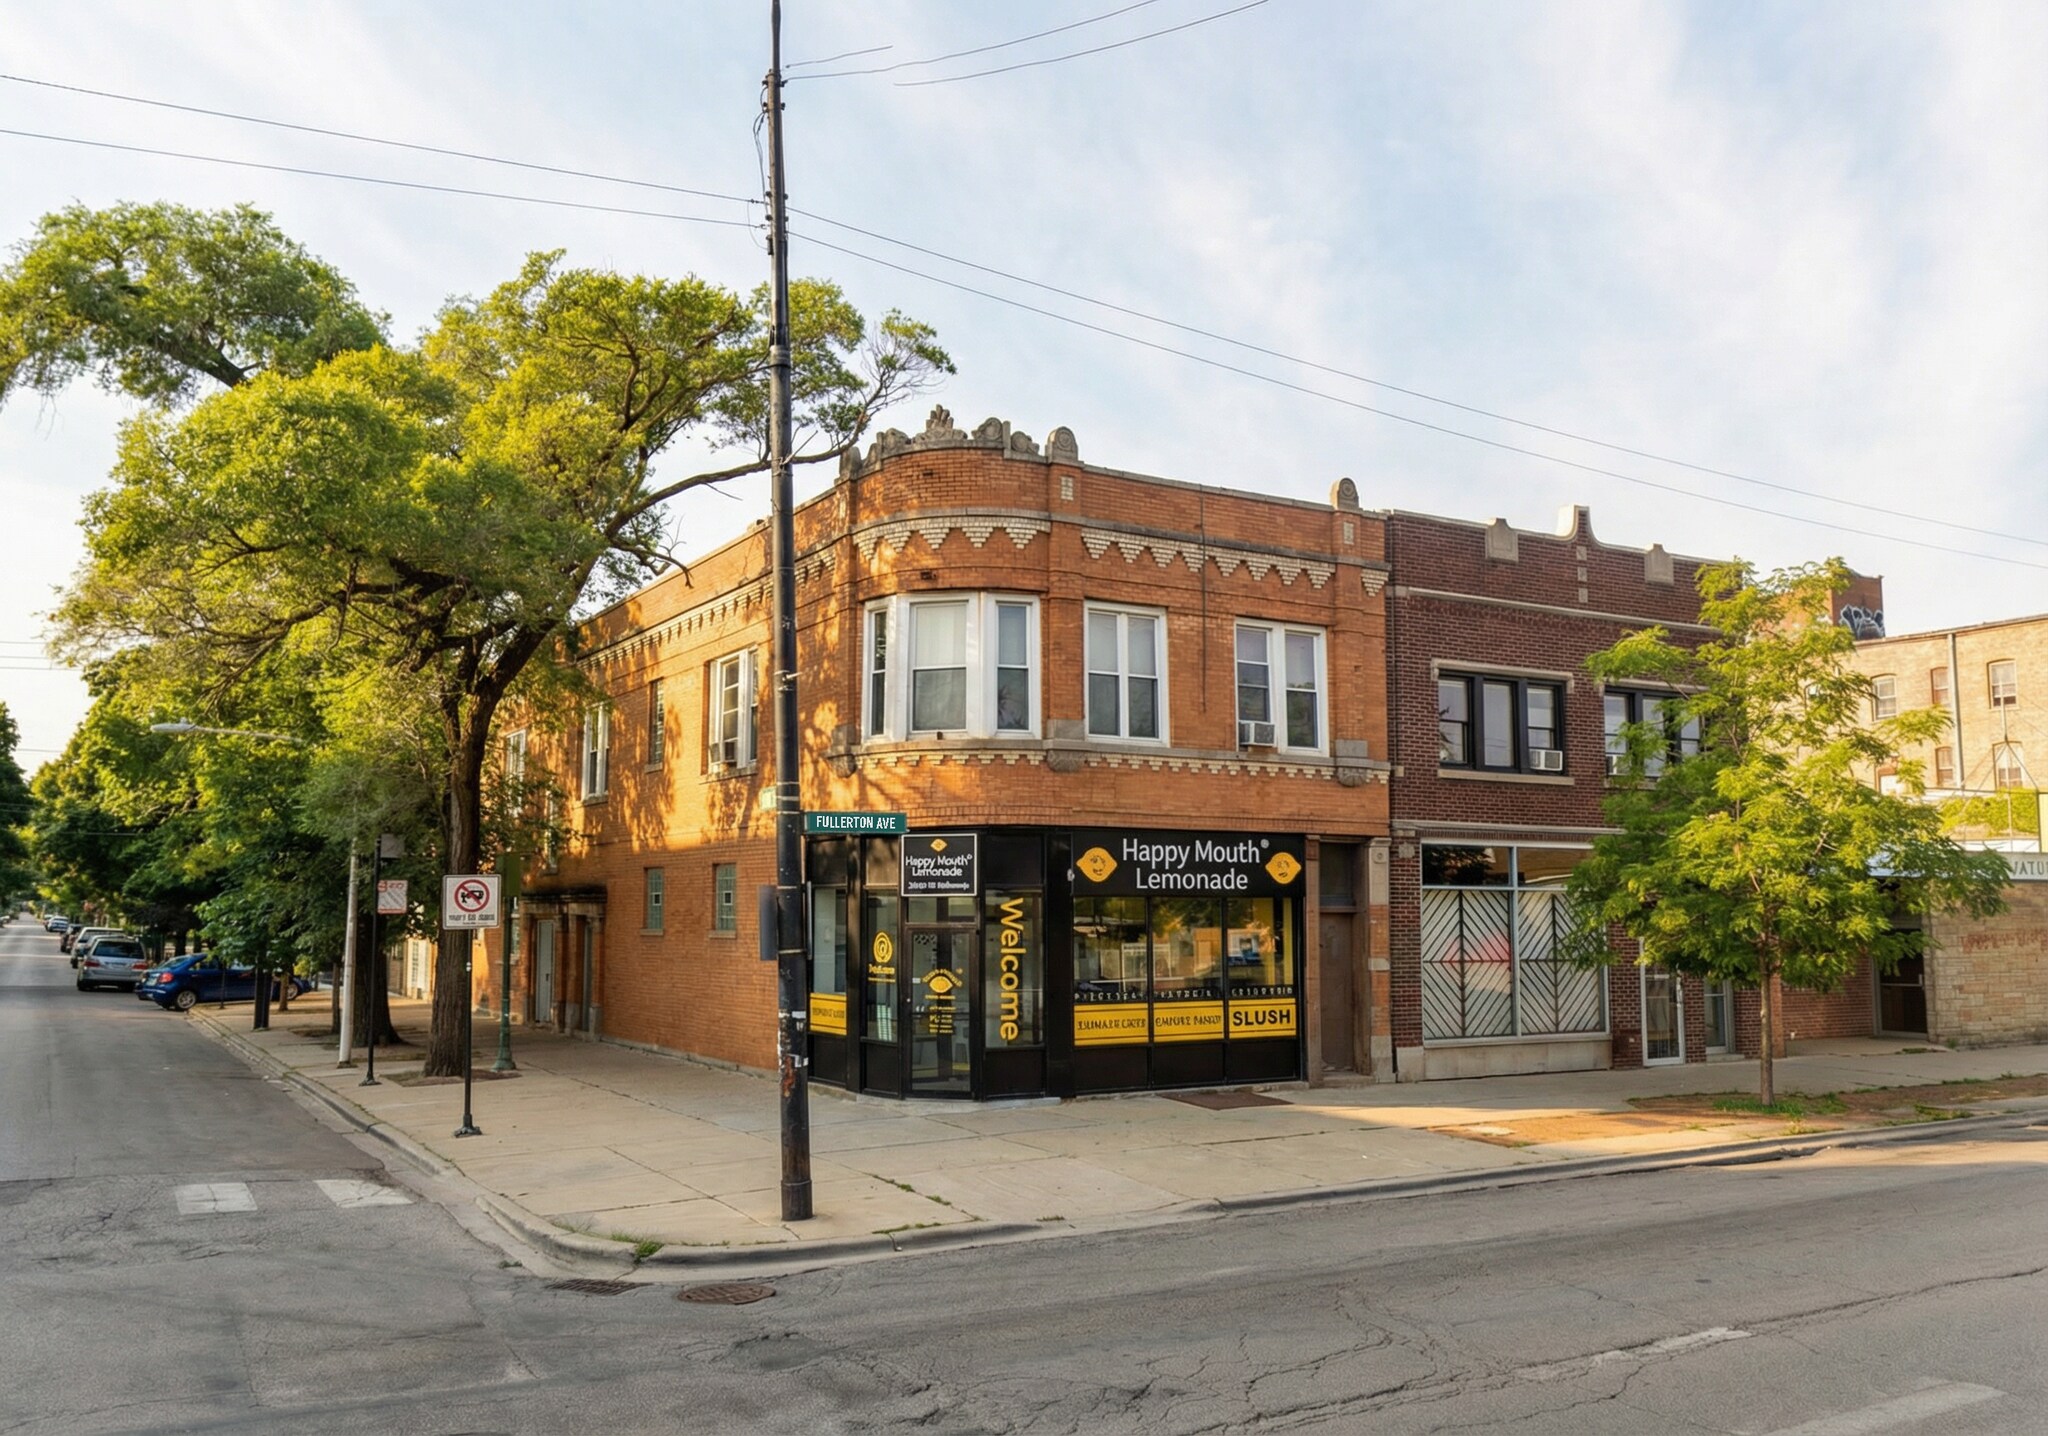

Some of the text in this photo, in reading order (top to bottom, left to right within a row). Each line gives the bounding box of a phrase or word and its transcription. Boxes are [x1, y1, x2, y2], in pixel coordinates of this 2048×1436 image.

[816, 815, 896, 829] FULLERTON AVE
[905, 855, 936, 870] Happy
[1122, 838, 1261, 870] Happy Mouth
[912, 866, 963, 877] Lemonade
[1136, 867, 1248, 890] Lemonade
[1000, 897, 1027, 1040] Welcome
[1232, 1009, 1291, 1027] SLUSH
